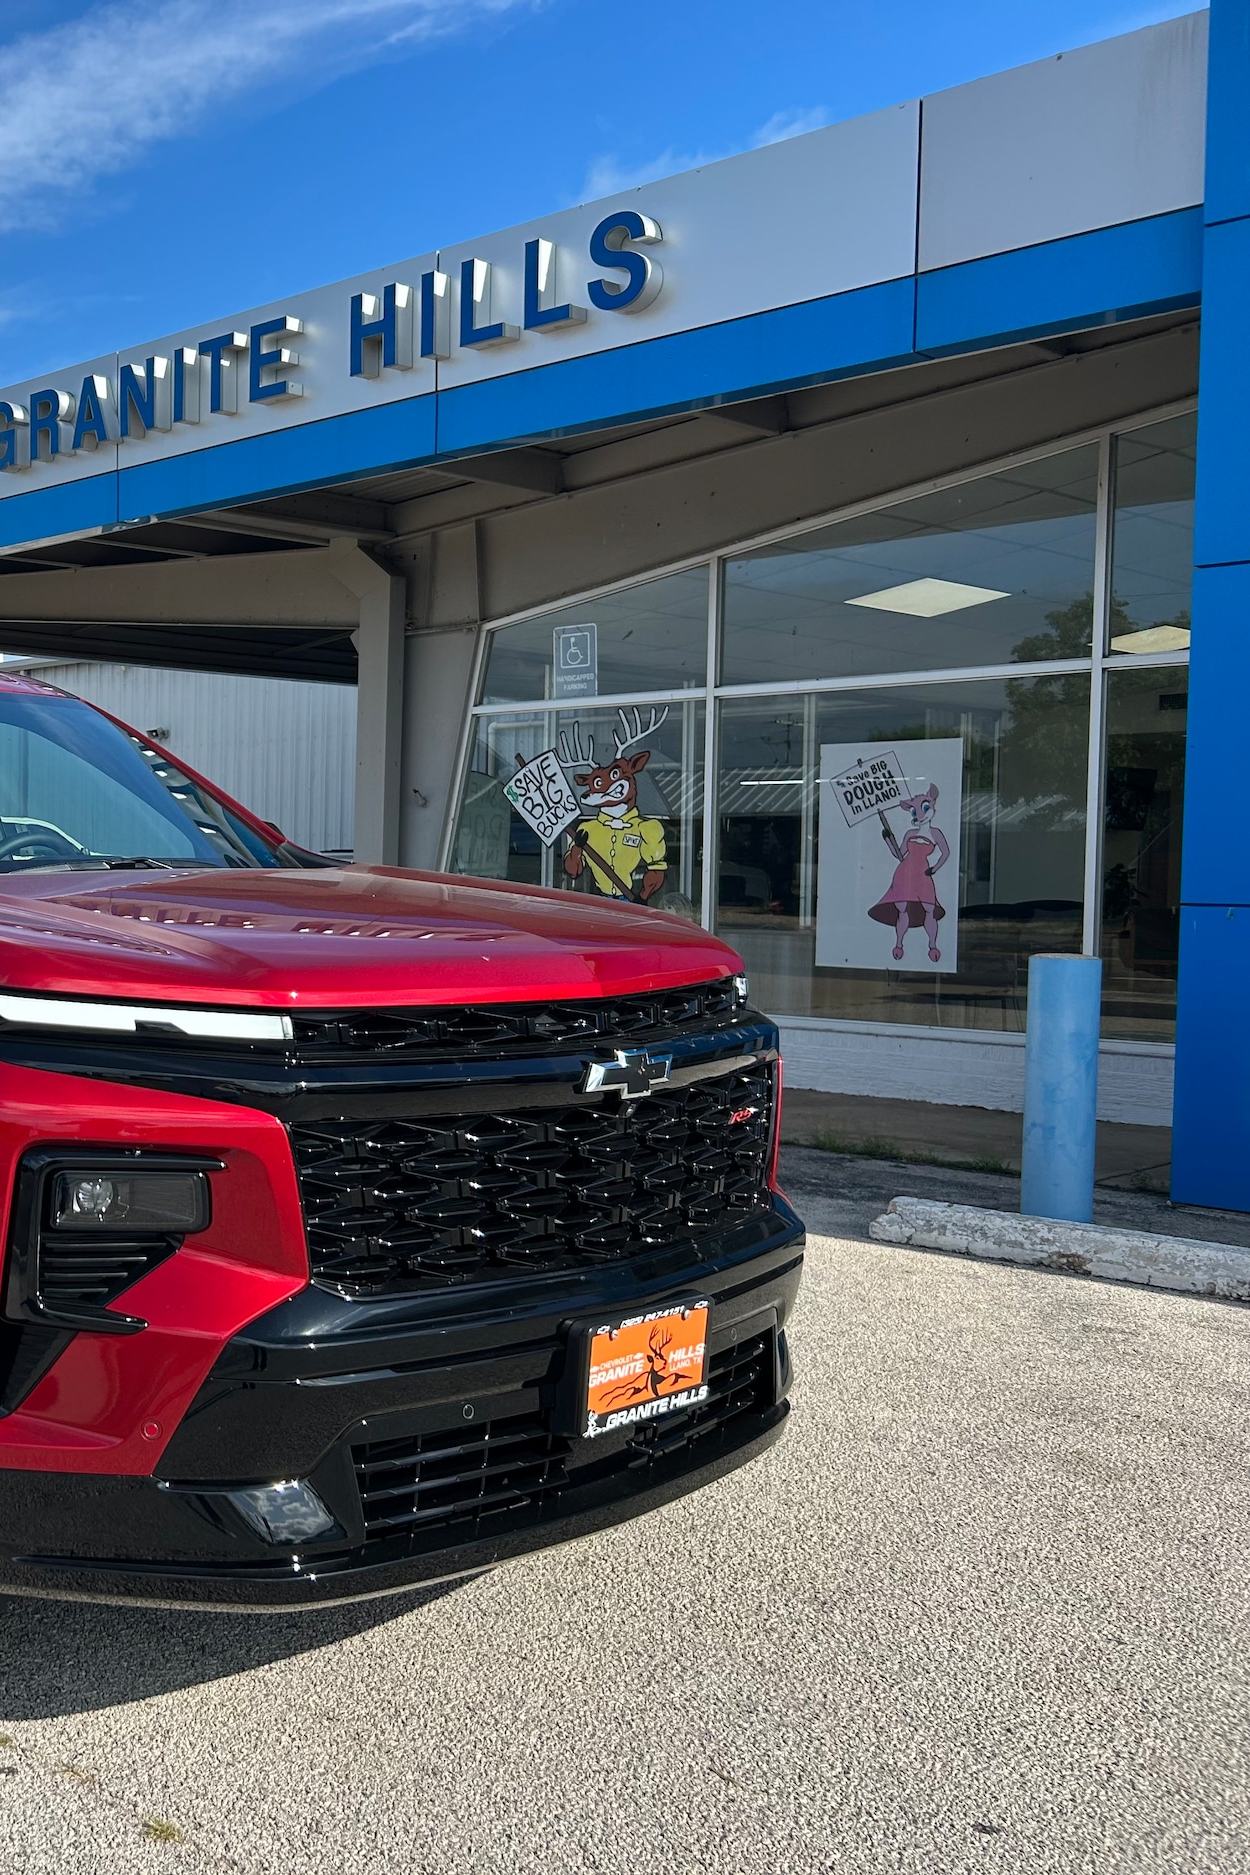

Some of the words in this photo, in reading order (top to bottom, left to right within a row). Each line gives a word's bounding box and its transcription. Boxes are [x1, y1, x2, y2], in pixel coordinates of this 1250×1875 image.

[350, 211, 662, 379] HILLS
[556, 672, 595, 682] HANDICAPPED
[563, 682, 588, 691] PARKING
[515, 755, 558, 798] SAVE
[846, 770, 870, 786] Save
[870, 760, 888, 775] BIG
[521, 779, 565, 821] BIG
[843, 770, 896, 805] DOUGH
[862, 785, 901, 810] LLANO!
[536, 794, 578, 839] BUCKS
[599, 1353, 634, 1370] CHEVROLET
[668, 1343, 706, 1363] HILLS
[692, 1357, 702, 1365] TX
[589, 1360, 644, 1387] GRANITE
[606, 1396, 669, 1429] GRANITE
[669, 1385, 709, 1411] HILLS
